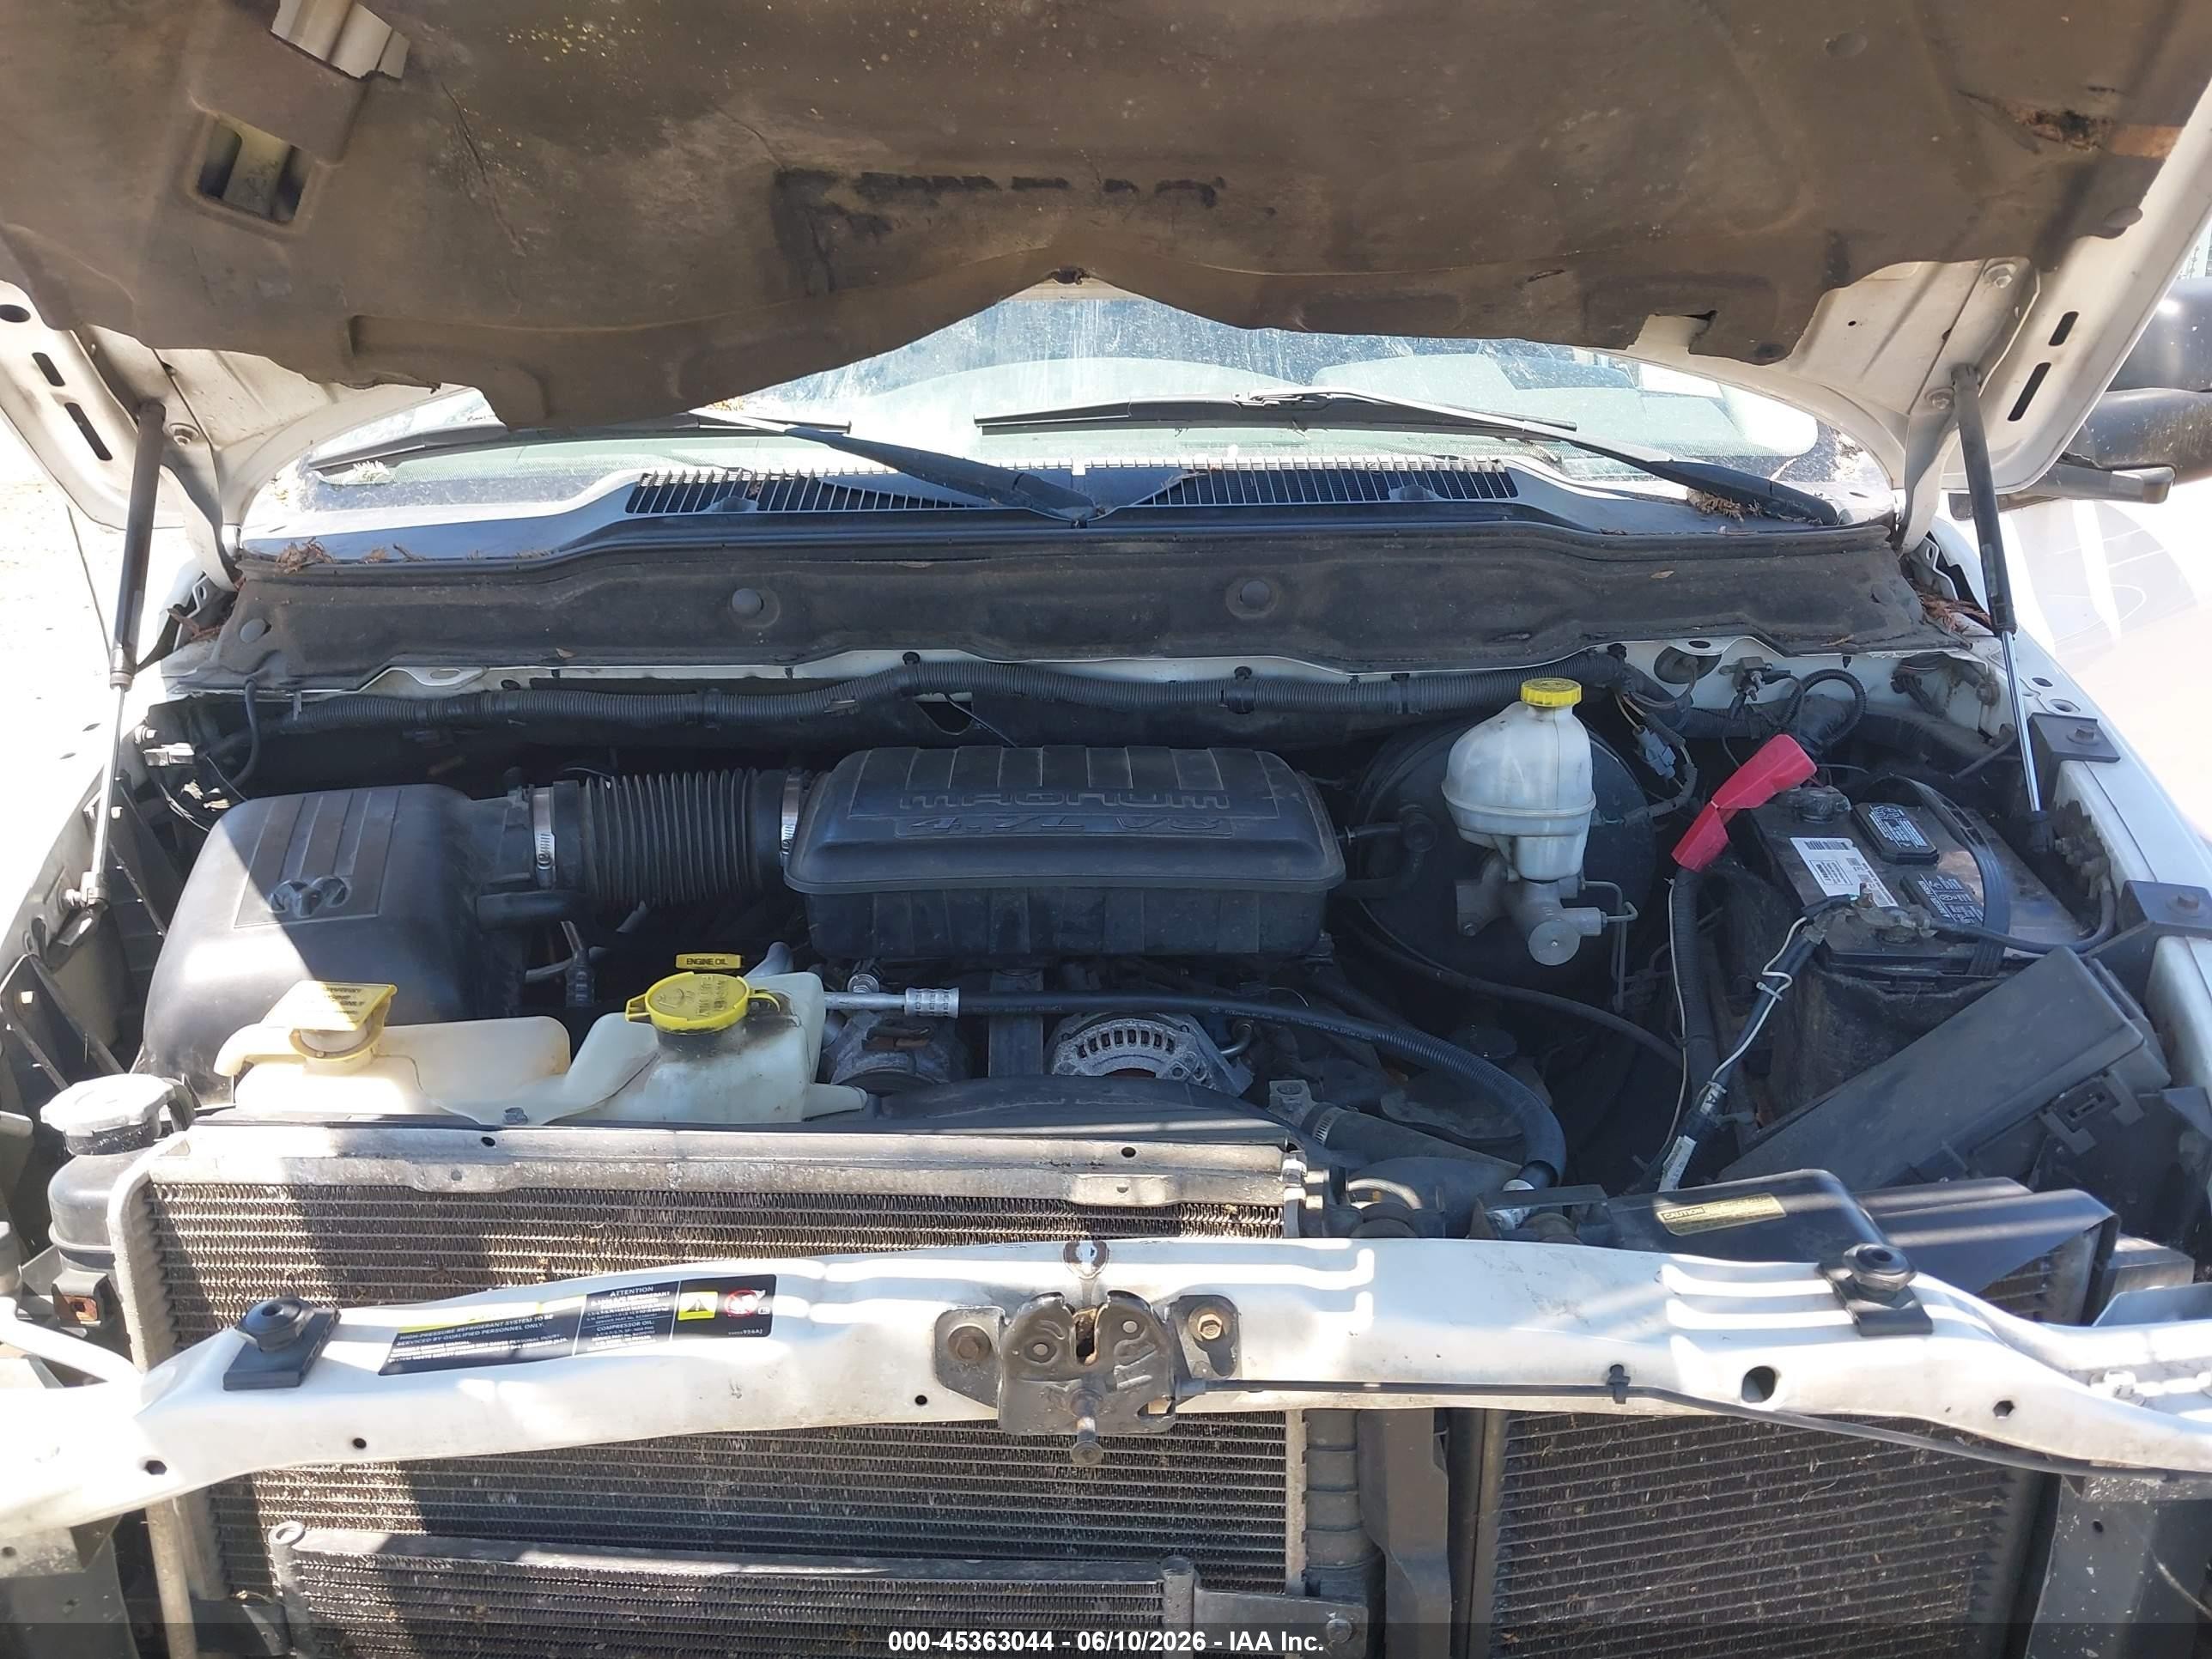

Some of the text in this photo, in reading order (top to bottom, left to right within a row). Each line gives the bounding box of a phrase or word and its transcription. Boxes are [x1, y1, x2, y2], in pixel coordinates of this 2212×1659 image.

[686, 957, 714, 966] ENGINE
[1663, 1207, 1705, 1219] CAUTION
[609, 1285, 654, 1297] ATTENTION
[481, 1325, 524, 1334] PERSONNEL
[597, 1322, 641, 1332] COMPRESSOR
